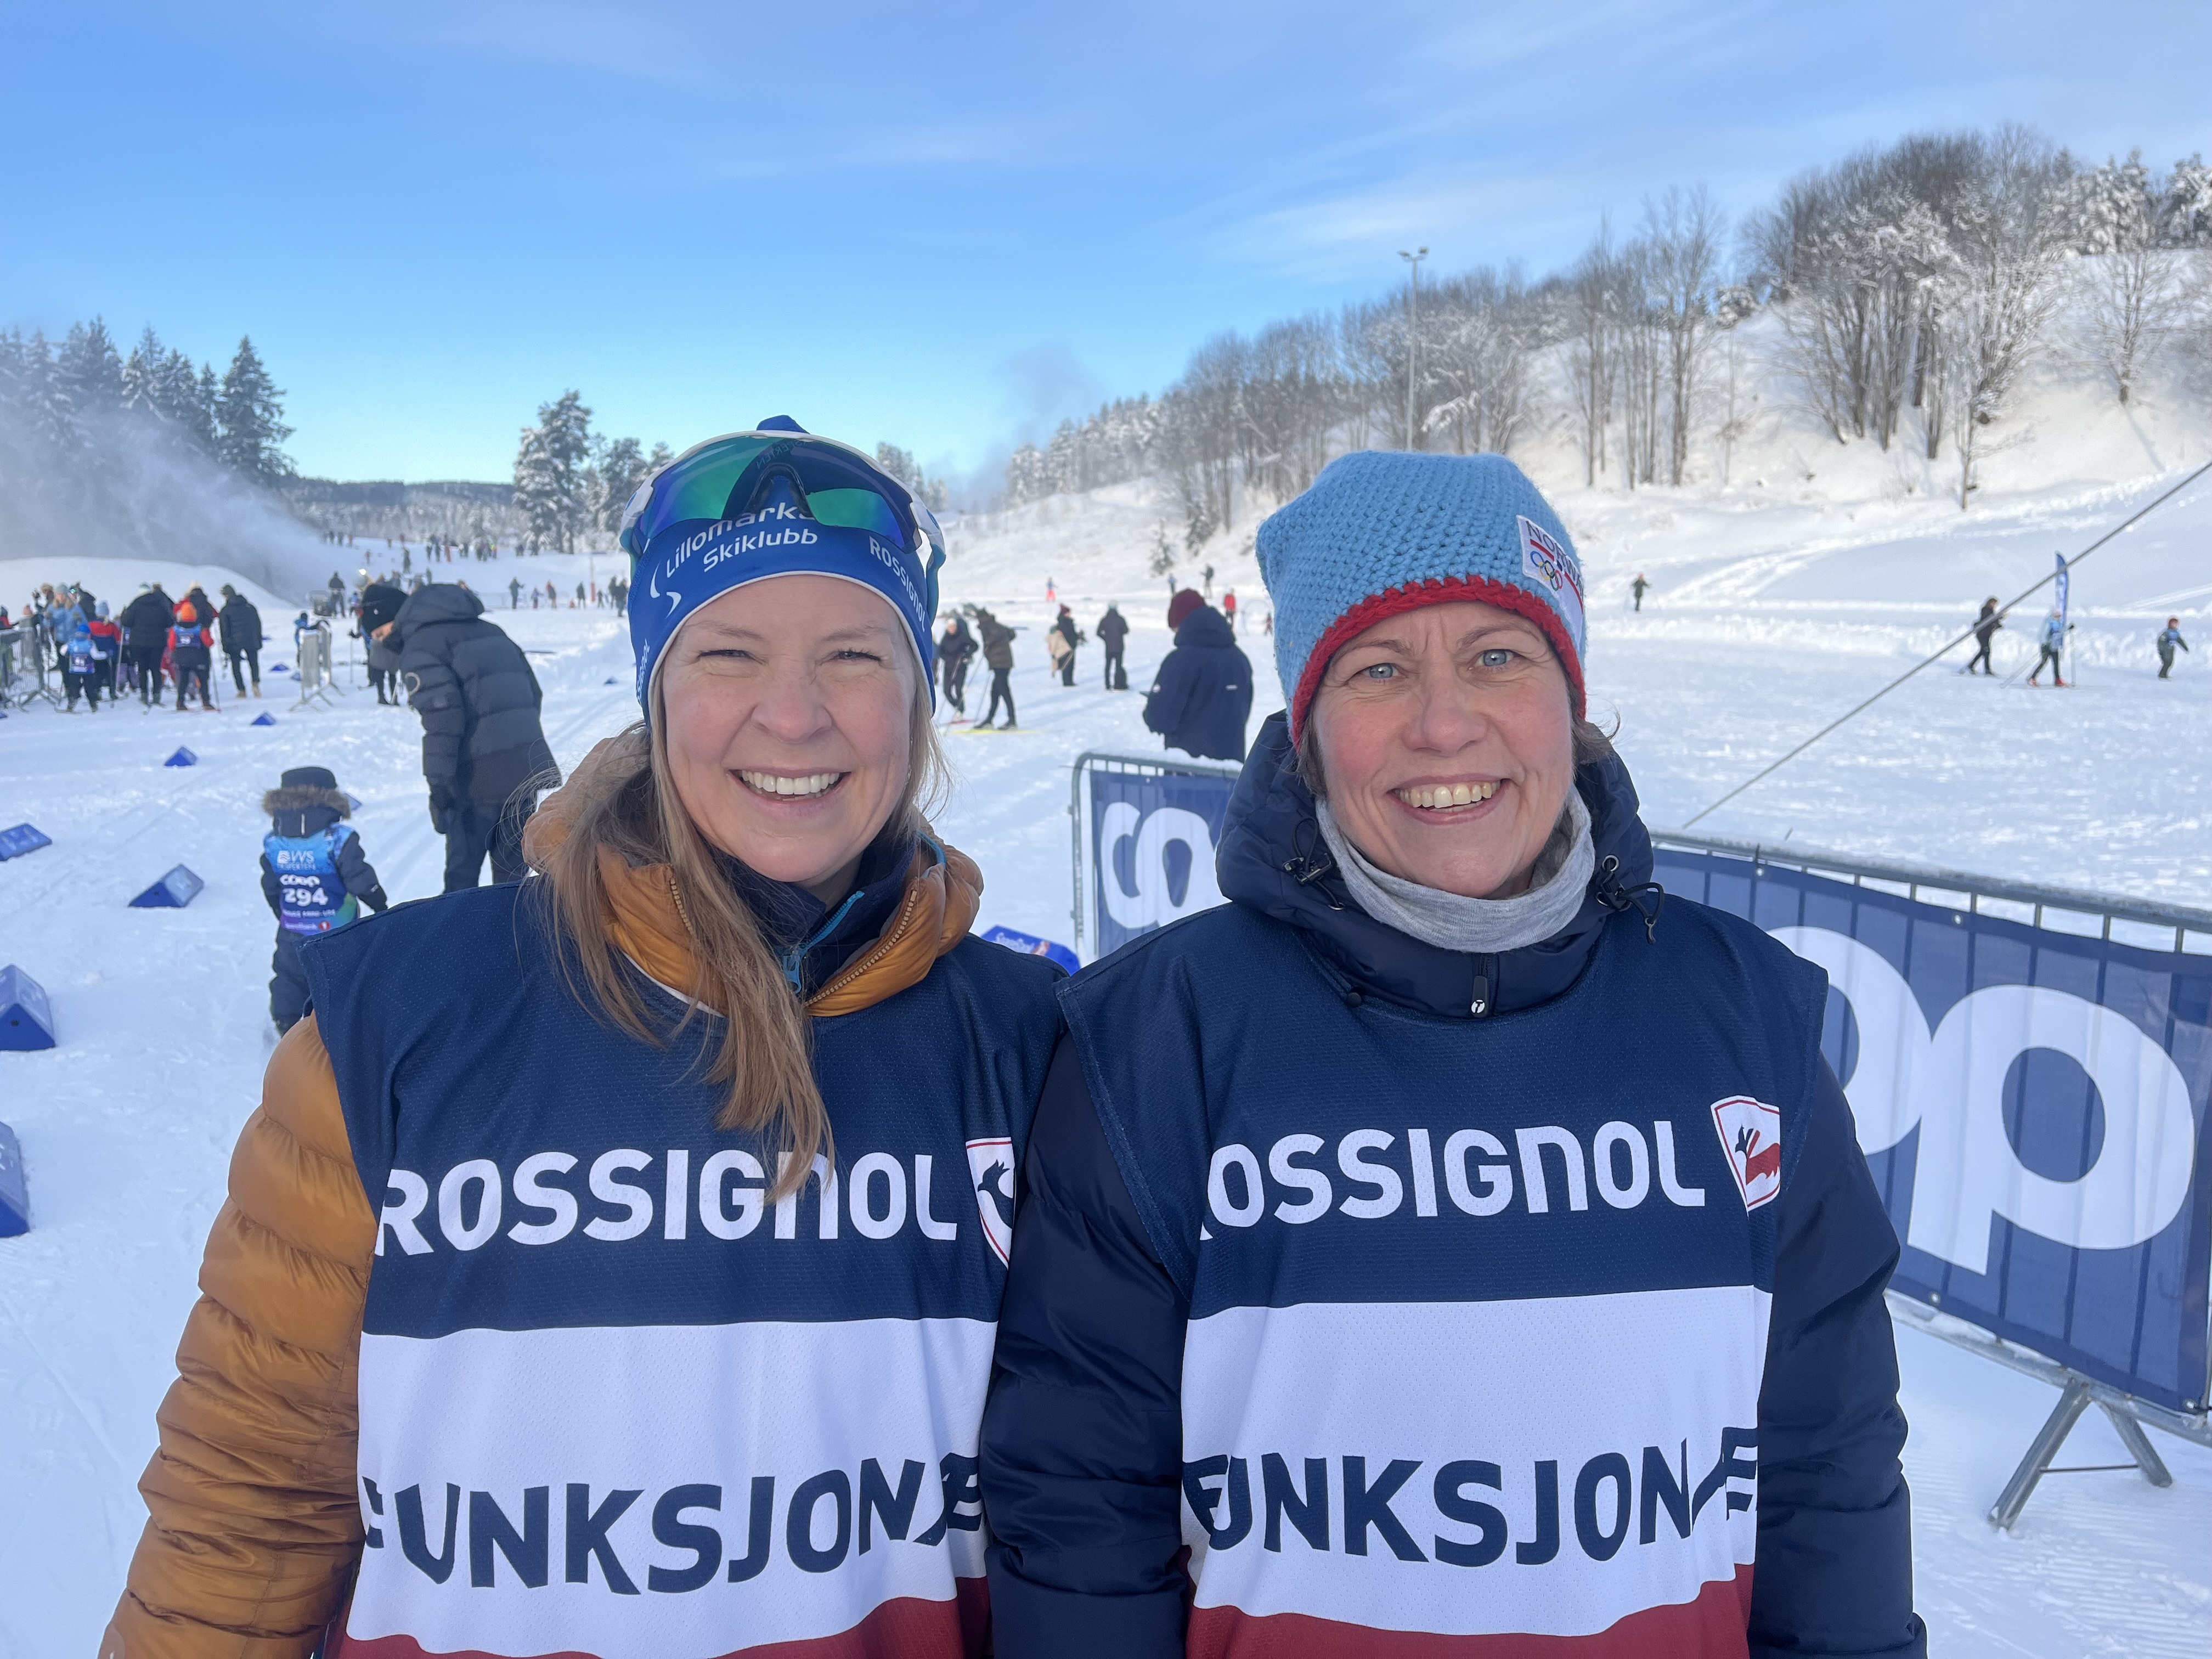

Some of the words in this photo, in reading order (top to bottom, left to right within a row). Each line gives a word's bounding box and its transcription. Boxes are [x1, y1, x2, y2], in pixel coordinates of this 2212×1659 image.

[703, 527, 819, 573] Skiklubb
[868, 535, 926, 633] ROSSIGNOL
[282, 887, 329, 907] 294
[1100, 802, 1233, 930] co
[374, 1149, 958, 1256] ROSSIGNOL
[1200, 1120, 1706, 1240] OSSIGNOL
